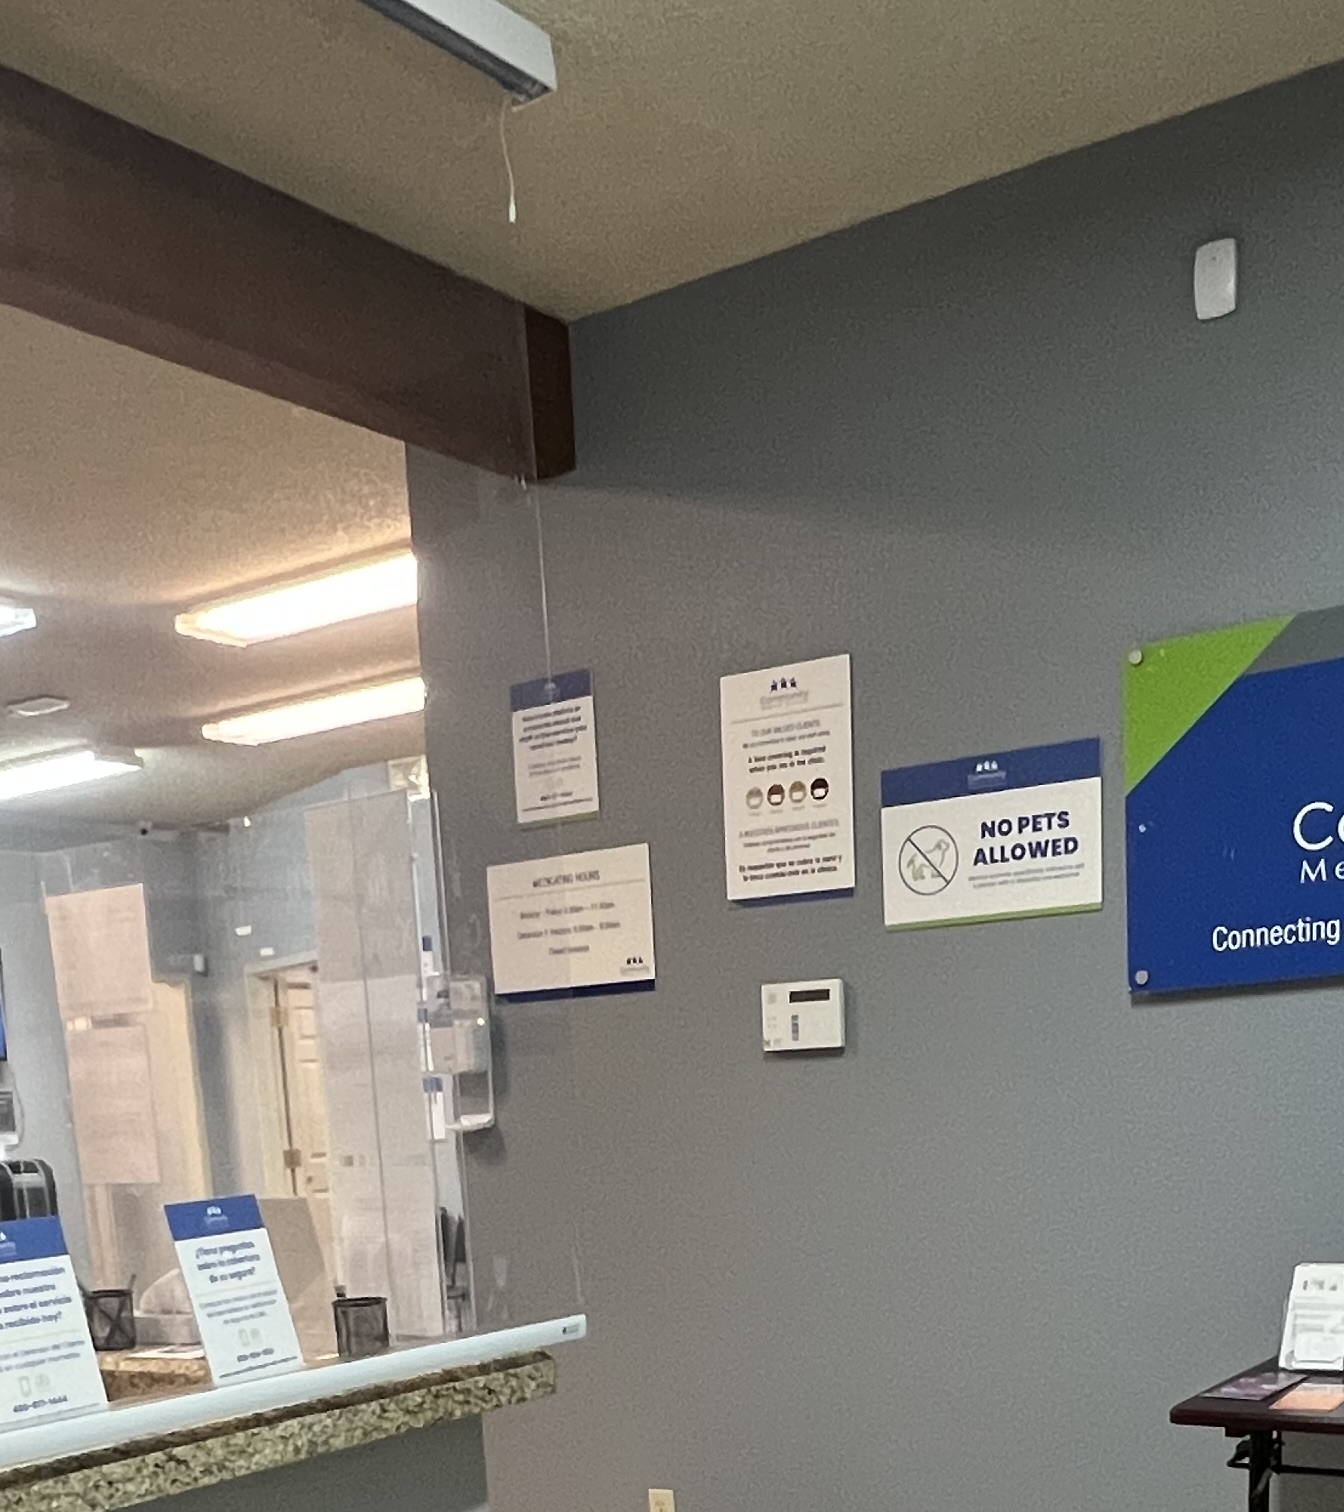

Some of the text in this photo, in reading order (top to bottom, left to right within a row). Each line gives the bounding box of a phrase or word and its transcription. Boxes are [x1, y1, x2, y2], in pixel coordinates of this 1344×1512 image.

[981, 811, 1070, 839] NO PETS
[973, 836, 1079, 866] ALLOWED
[1212, 916, 1341, 952] Connecting
